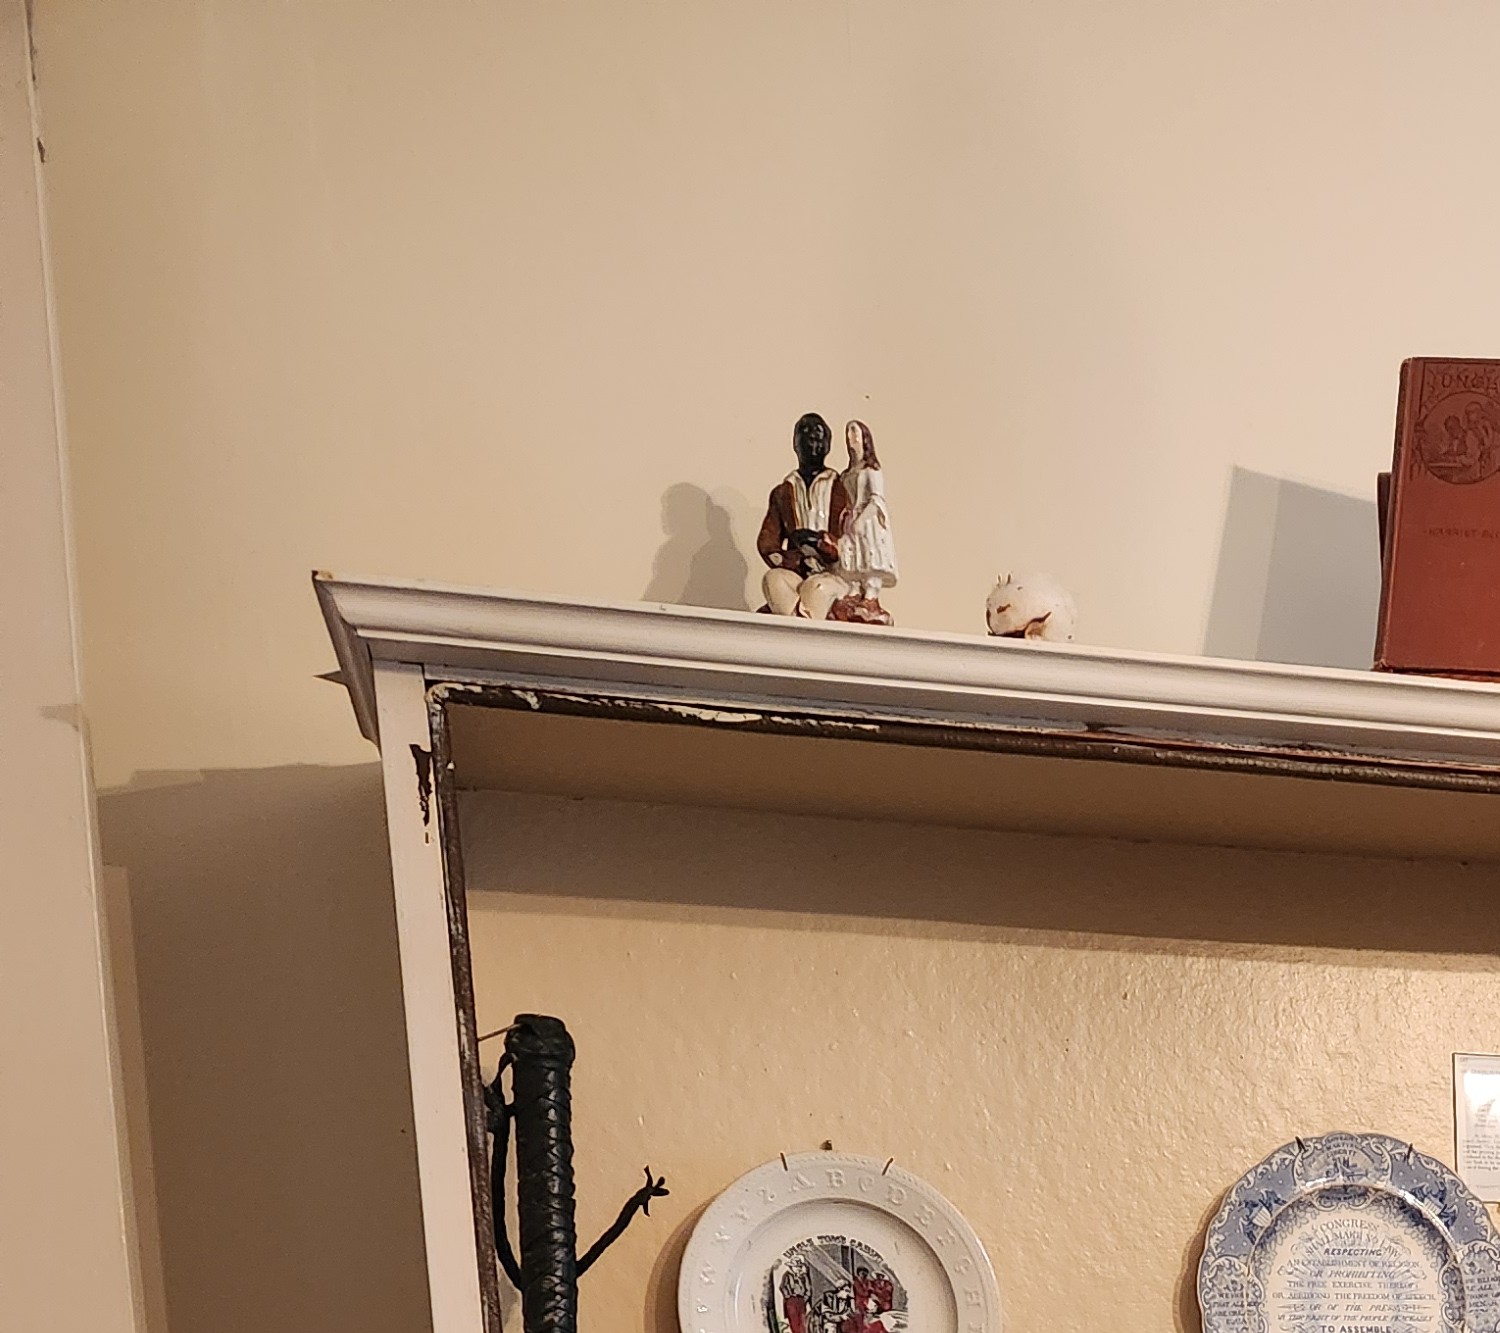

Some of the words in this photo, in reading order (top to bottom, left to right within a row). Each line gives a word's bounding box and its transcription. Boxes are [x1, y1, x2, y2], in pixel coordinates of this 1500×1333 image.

[1320, 1218, 1380, 1233] CONGRESS
[1323, 1248, 1382, 1256] RESPECTING
[1321, 1325, 1336, 1333] TO
